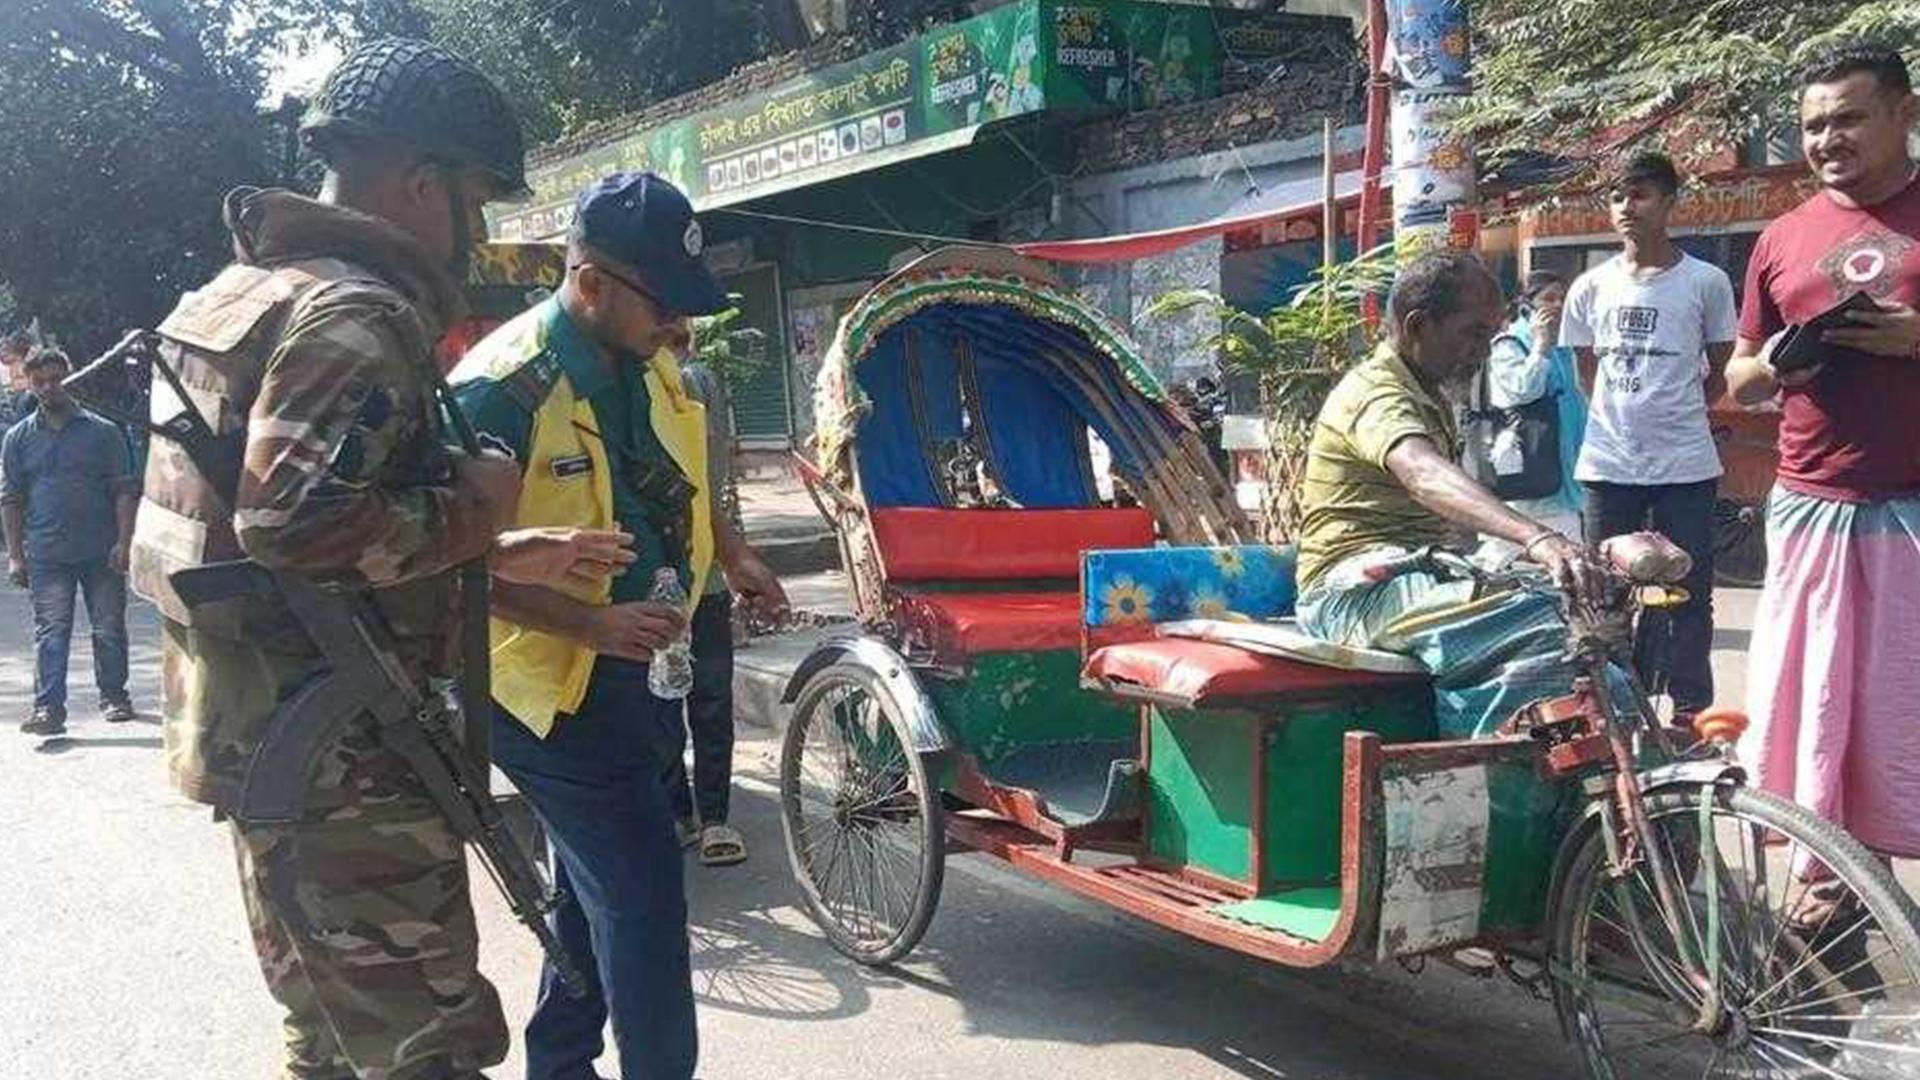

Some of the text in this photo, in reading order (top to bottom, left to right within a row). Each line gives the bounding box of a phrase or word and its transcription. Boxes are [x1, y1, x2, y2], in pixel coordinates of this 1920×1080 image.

[1056, 47, 1117, 67] REFRESHER
[739, 113, 761, 137] এর
[764, 97, 815, 129] বিখ্যাত
[815, 76, 871, 112] কালাই
[1620, 309, 1655, 330] PUBG
